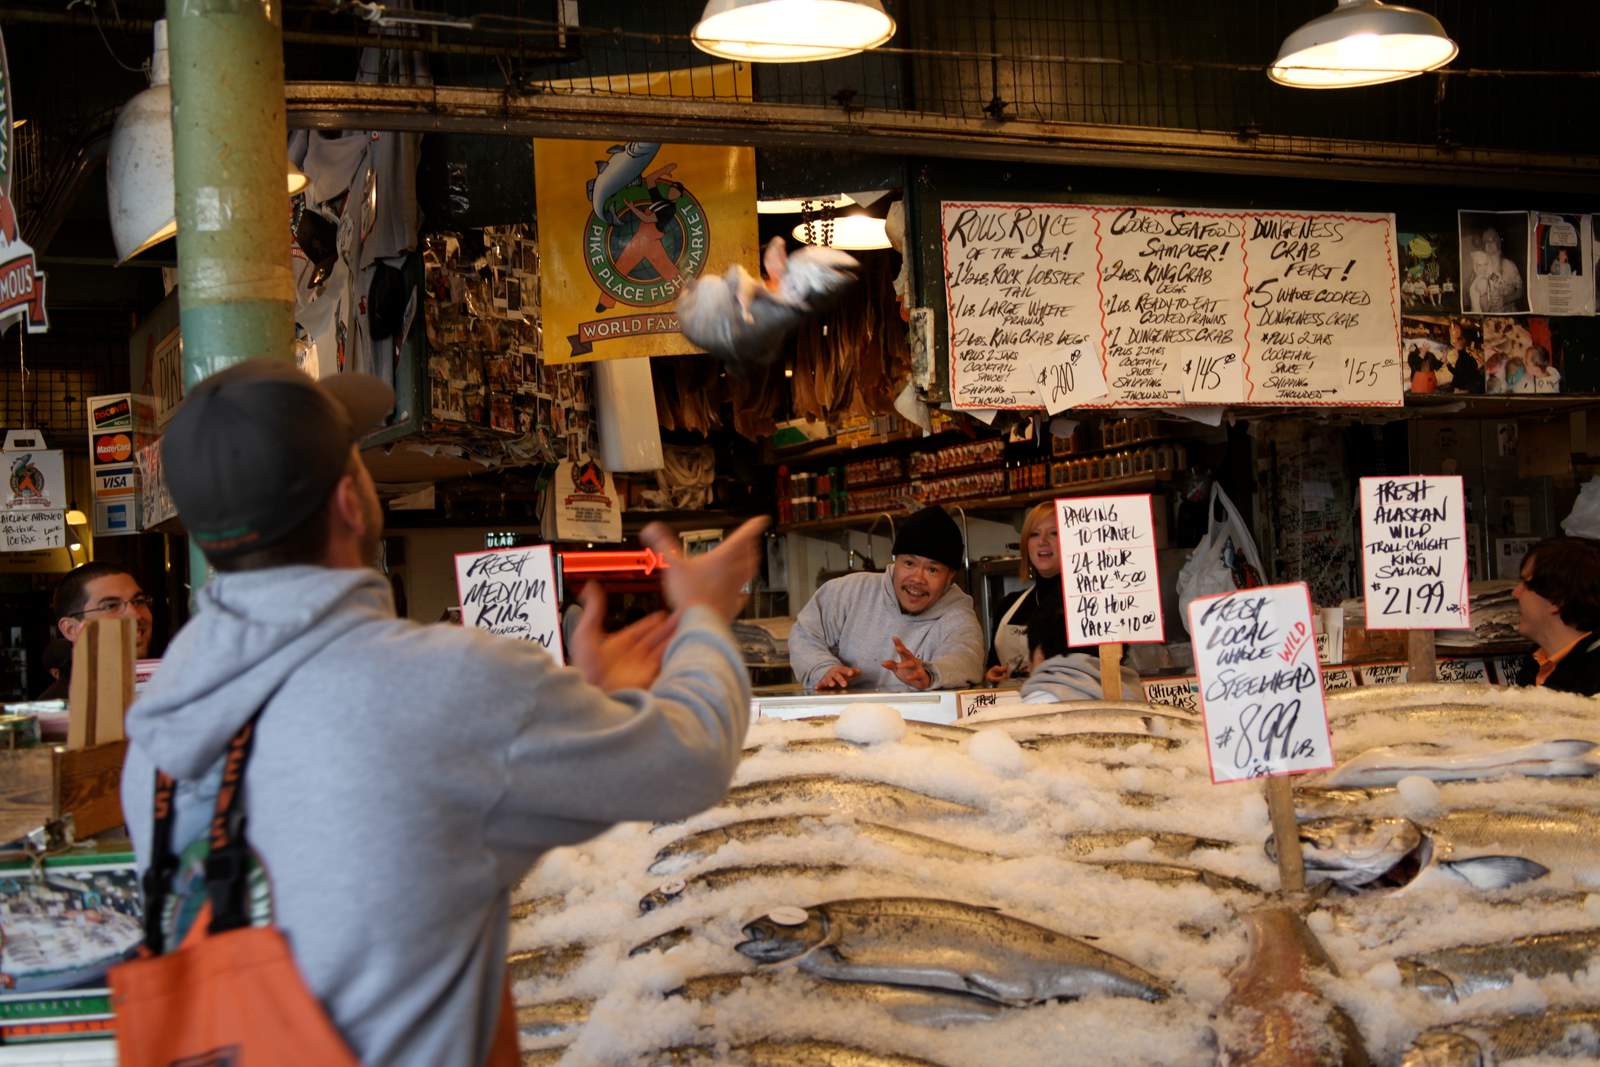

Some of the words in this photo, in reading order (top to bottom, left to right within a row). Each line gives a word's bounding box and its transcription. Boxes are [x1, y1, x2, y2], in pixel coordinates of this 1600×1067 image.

[948, 208, 1007, 249] ROLLS
[1008, 207, 1081, 247] ROYCE
[1110, 208, 1165, 236] COOKED
[1164, 212, 1241, 240] SEAFOOD
[1250, 216, 1345, 243] DUNGENESS
[588, 223, 605, 266] PIKE
[598, 268, 645, 301] PLACE
[650, 274, 688, 300] FISH
[680, 204, 704, 277] MARKET
[966, 247, 985, 260] OF
[991, 247, 1020, 260] THE
[1138, 237, 1231, 262] SAMPLER!
[1270, 240, 1321, 262] CRAB
[990, 263, 1024, 285] ROCK
[1026, 264, 1086, 286] LOBSTER
[1143, 261, 1177, 286] KING
[1177, 262, 1213, 285] CRAB
[999, 286, 1036, 298] TAIL
[1156, 282, 1189, 295] LEGS
[1276, 287, 1316, 304] WHOLE
[1314, 288, 1372, 305] COOKED
[978, 297, 1024, 319] LARGE
[1028, 299, 1078, 318] WHITE
[1140, 310, 1186, 325] COOKED
[1186, 311, 1228, 326] PRAWNS
[1256, 306, 1326, 328] DUNGENESS
[1325, 310, 1360, 329] CRAB
[583, 318, 642, 338] WORLD
[1002, 315, 1045, 326] PRAWNS
[989, 327, 1017, 348] KING
[1018, 328, 1055, 346] CRAB
[1128, 327, 1195, 345] DUNGENESS
[1194, 327, 1234, 344] CRAB
[1119, 356, 1164, 368] COCKTAIL
[1261, 348, 1316, 362] COCKTAIL
[963, 362, 1017, 373] COCKTAIL
[959, 383, 1006, 396] SHIPPING
[1112, 376, 1163, 389] SHIPPING
[1262, 375, 1309, 389] SHIPPING
[969, 395, 1017, 405] INCLUDED
[1121, 389, 1169, 400] INCLUDED
[1275, 389, 1322, 400] INCLUDED
[103, 476, 127, 489] VISA
[1374, 479, 1436, 505] FRESH
[1062, 503, 1118, 528] PACKING
[1374, 496, 1447, 524] ALASKAN
[1074, 529, 1092, 546] TO
[1094, 526, 1145, 543] TRAVEL
[1389, 523, 1432, 539] WILD
[466, 551, 534, 579] FRESH
[1071, 551, 1094, 574] 24
[1097, 549, 1136, 571] HOUR
[1375, 556, 1442, 578] SALMON
[1391, 552, 1426, 566] KING
[464, 579, 547, 606] MEDIUM
[475, 601, 529, 628] KING
[1077, 594, 1099, 617] 48
[1104, 594, 1139, 614] HOUR
[1200, 595, 1273, 627] FRESH
[1206, 621, 1279, 650] LOCAL
[1216, 642, 1279, 666] WHOLE
[1276, 622, 1306, 662] WILD
[1149, 682, 1191, 698] CHILEAN
[1205, 662, 1317, 702] STEELHEAD
